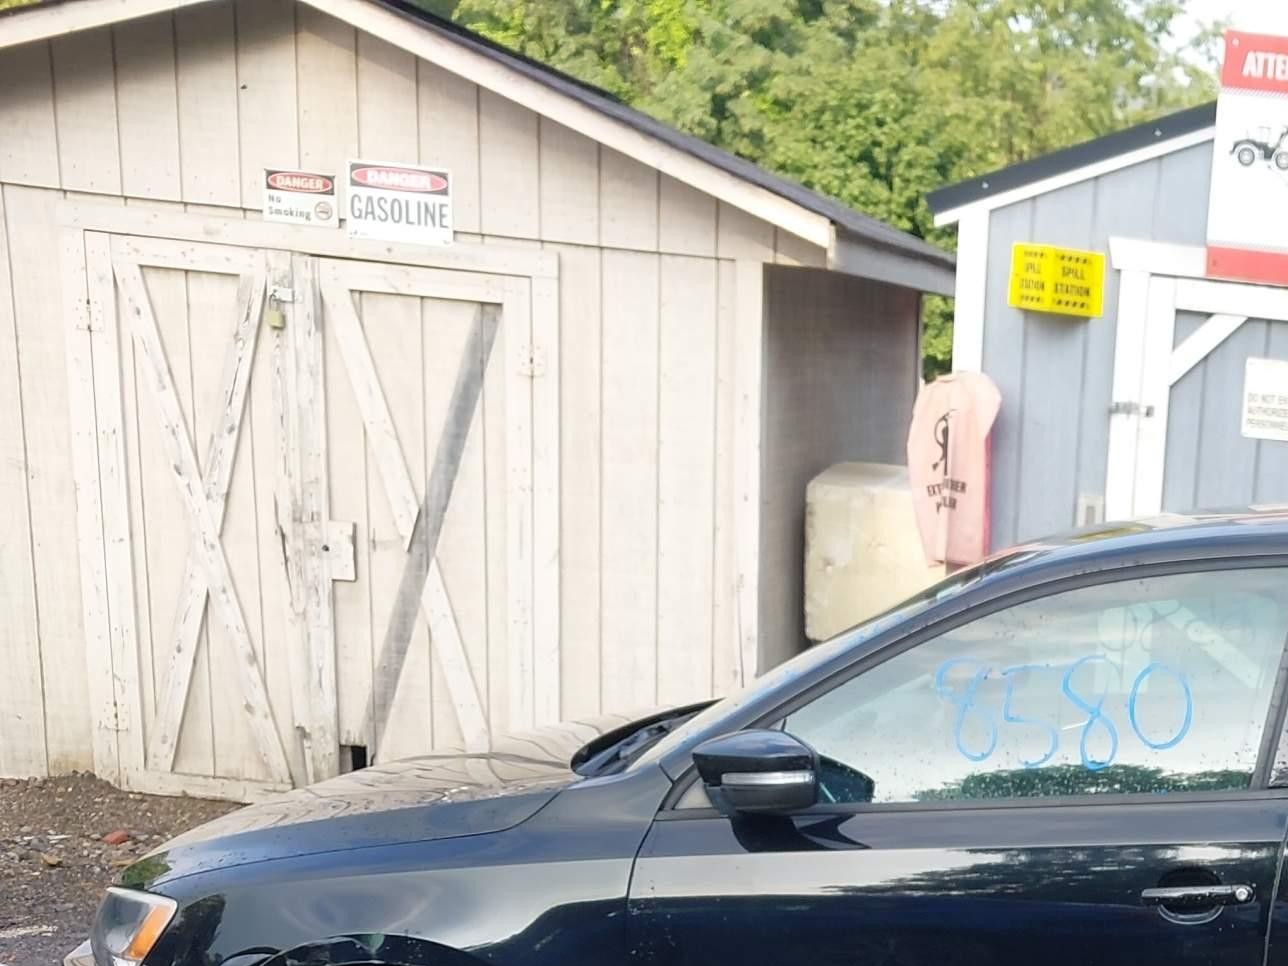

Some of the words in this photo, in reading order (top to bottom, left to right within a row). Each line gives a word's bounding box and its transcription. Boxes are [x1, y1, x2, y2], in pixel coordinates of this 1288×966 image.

[276, 175, 324, 190] DANGER
[366, 169, 431, 189] DANGER
[268, 193, 282, 203] No
[268, 206, 312, 221] Smoking
[350, 194, 449, 228] GASOLINE
[936, 655, 1192, 771] 8580
